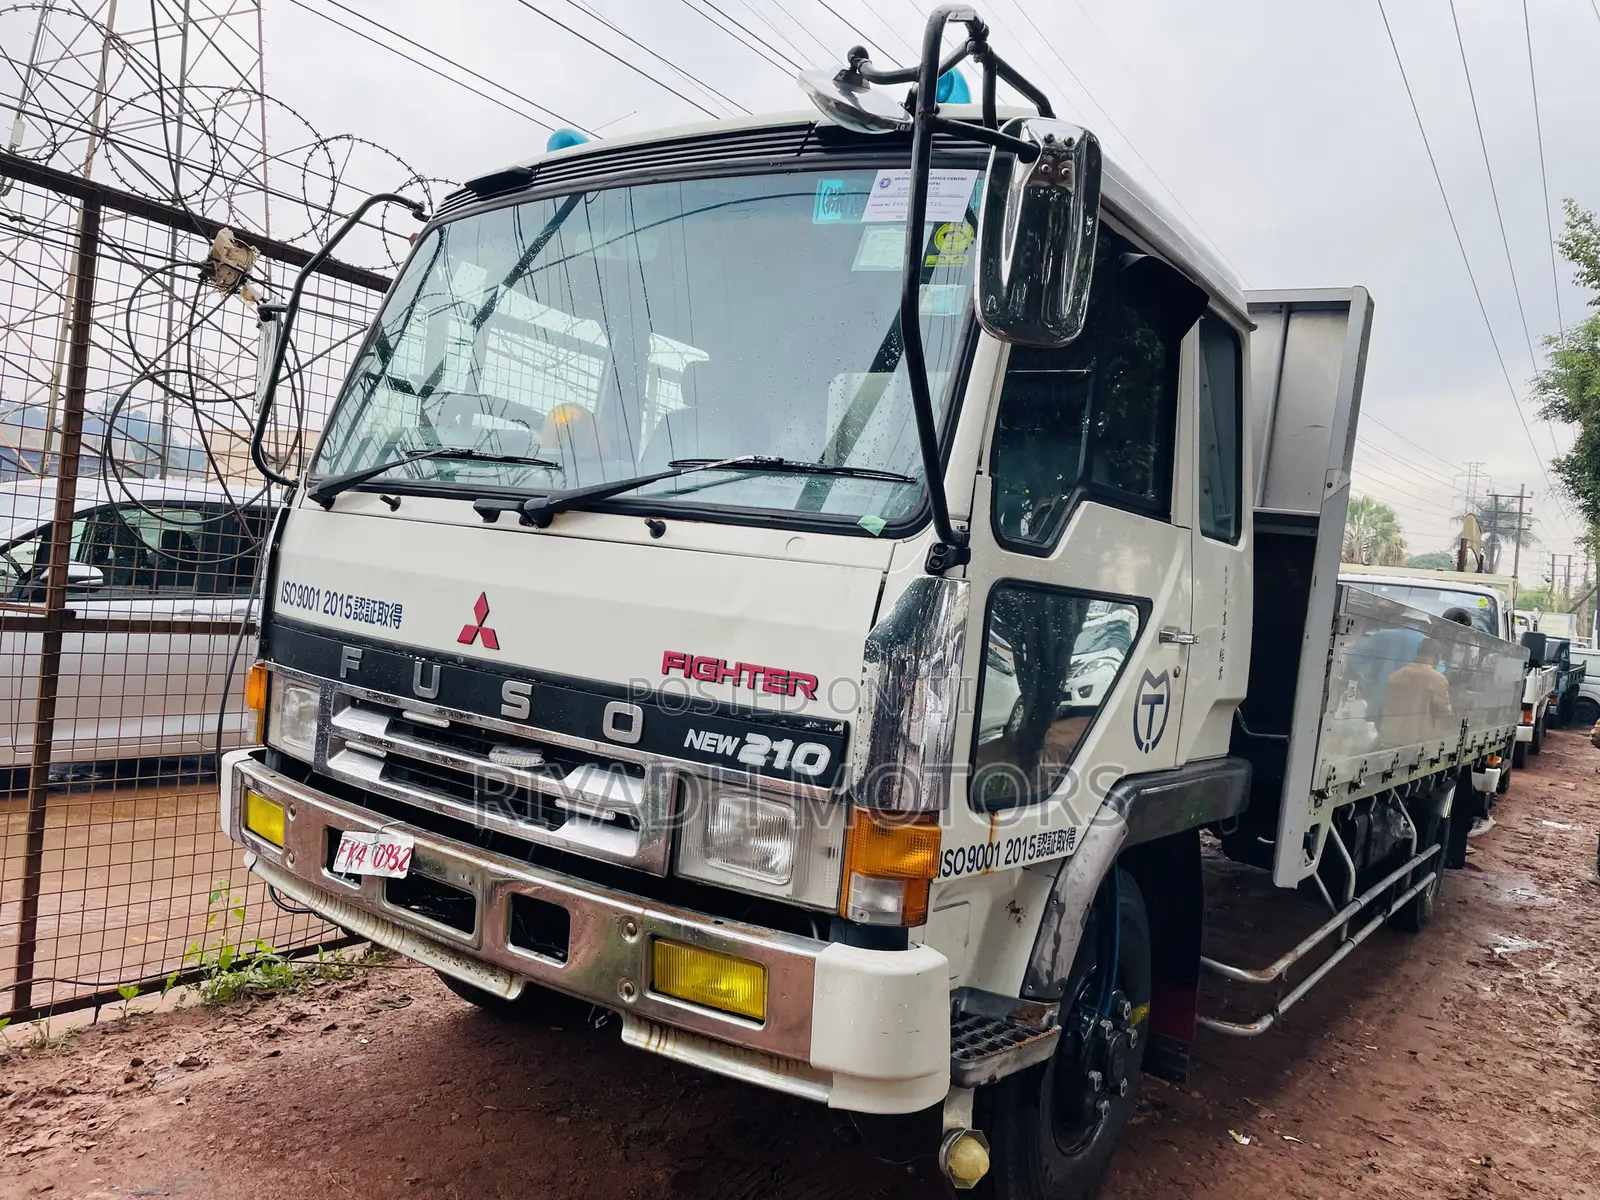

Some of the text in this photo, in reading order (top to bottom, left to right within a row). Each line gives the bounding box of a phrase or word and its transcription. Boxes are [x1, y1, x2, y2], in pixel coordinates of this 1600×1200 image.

[281, 580, 320, 612] ISO9001
[340, 645, 644, 744] FUSO
[661, 650, 819, 701] FIGHTER
[683, 728, 832, 776] NEW 210
